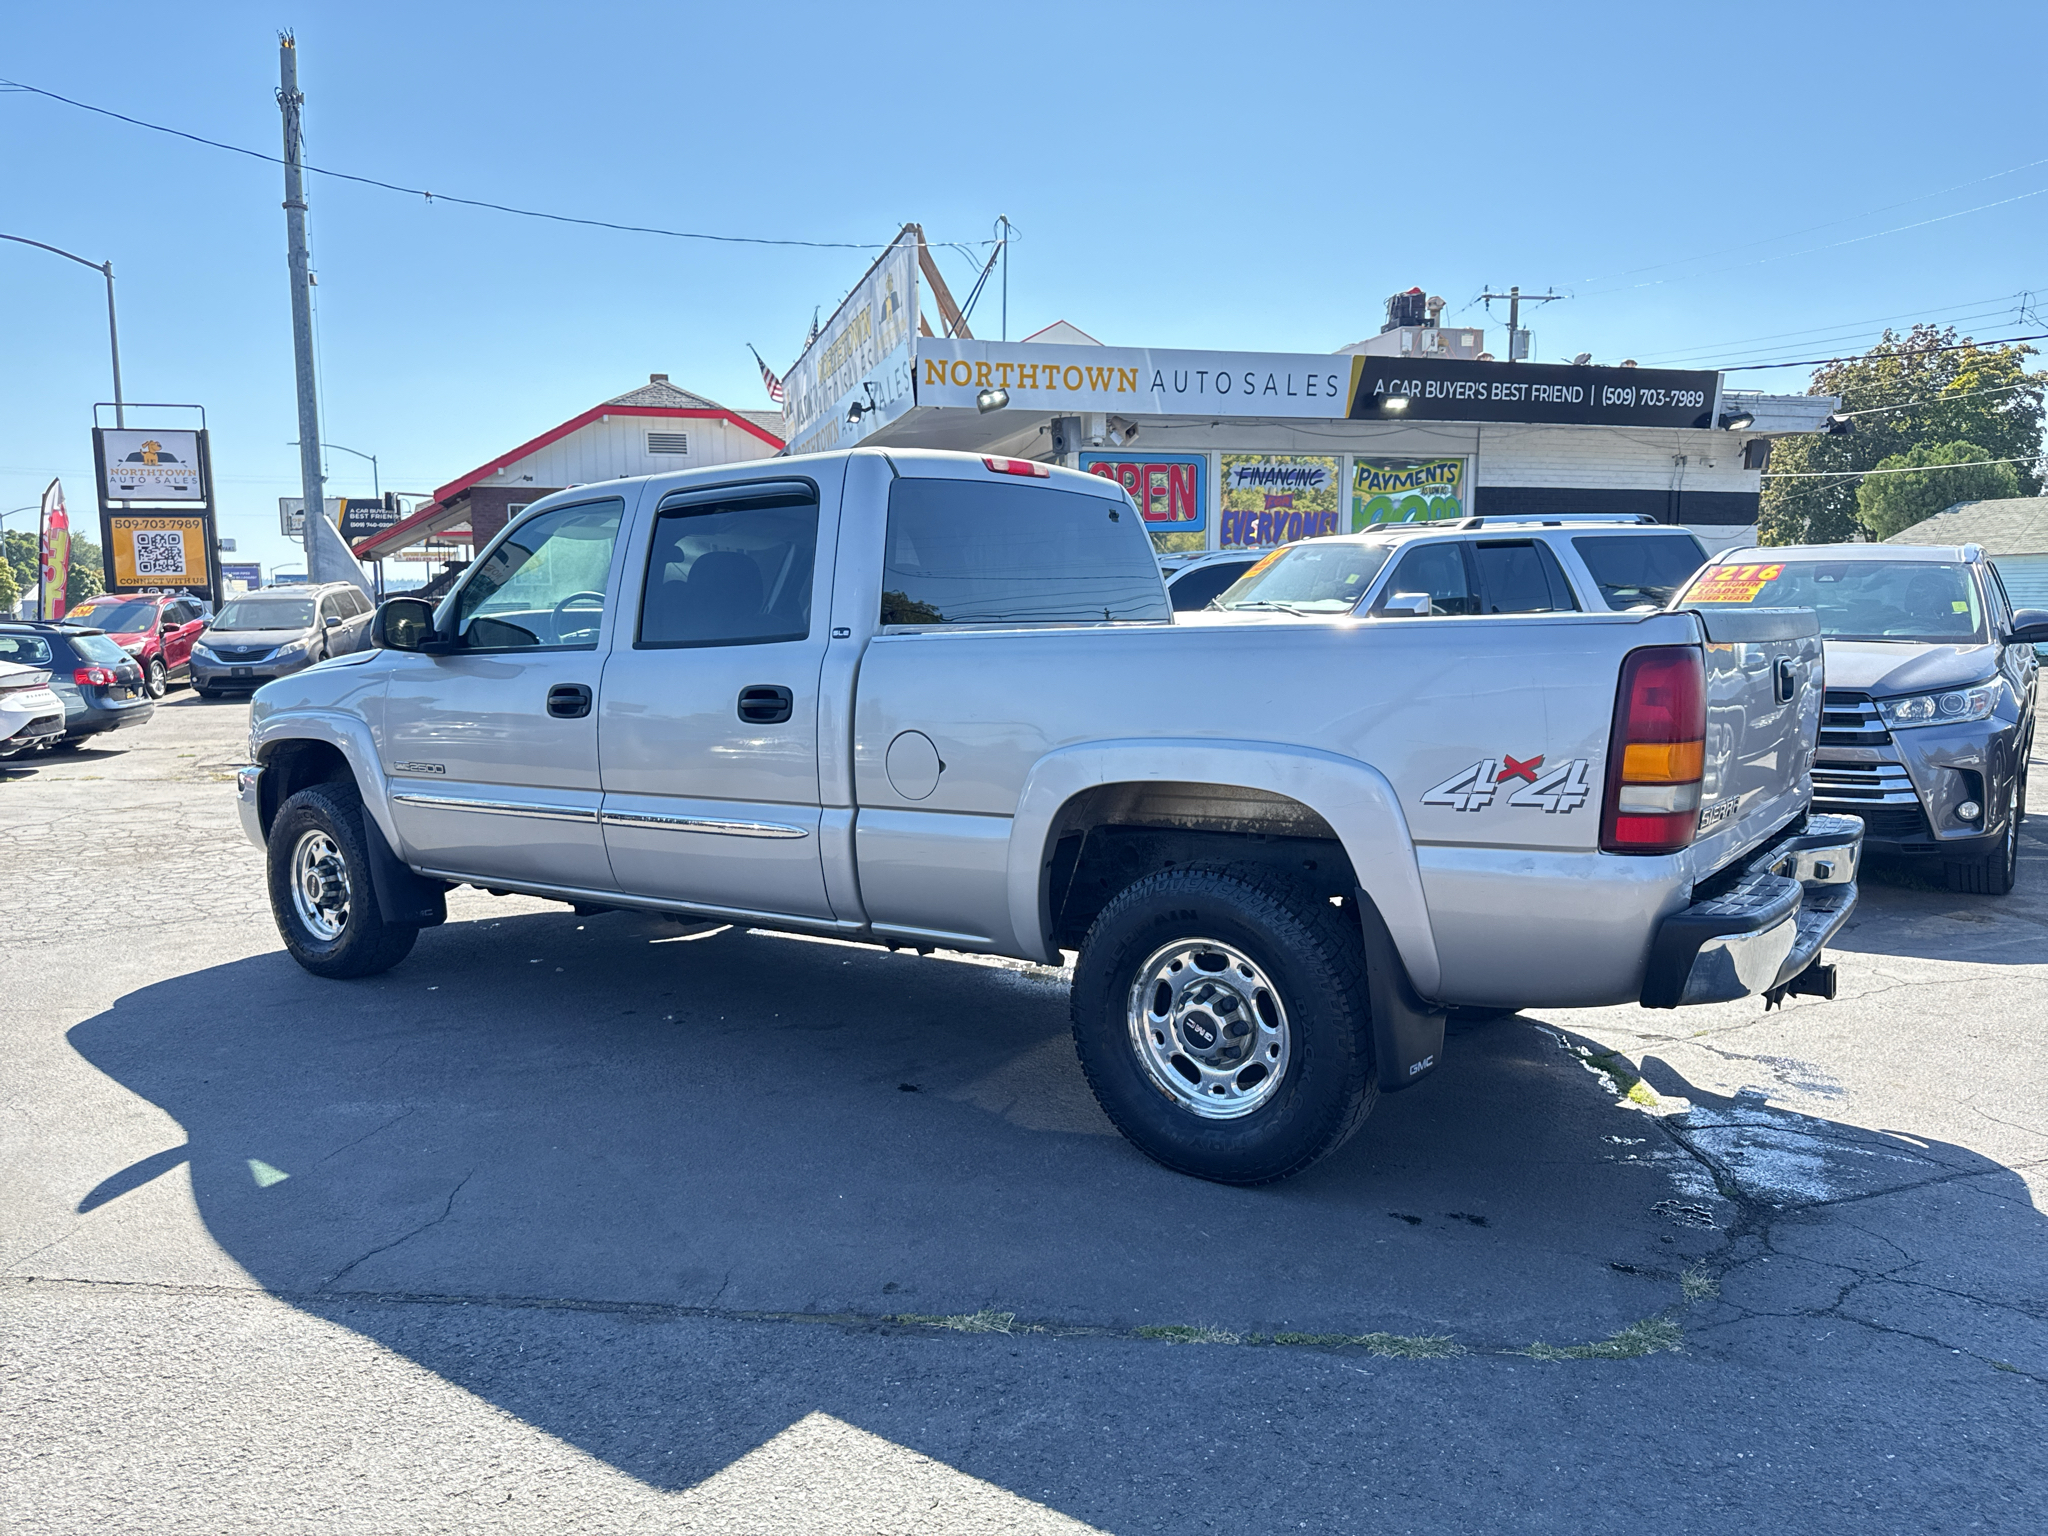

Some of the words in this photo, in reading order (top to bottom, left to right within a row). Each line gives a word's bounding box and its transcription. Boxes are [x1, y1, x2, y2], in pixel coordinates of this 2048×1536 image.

[925, 359, 1139, 393] NORTHTOWN
[1150, 369, 1232, 395] AUTO
[1243, 371, 1338, 397] SALES
[1374, 379, 1385, 396] A
[1389, 379, 1421, 398] CAR
[1426, 380, 1487, 400] BUYER'S
[1491, 383, 1528, 401] BEST
[1531, 384, 1583, 403] FRIEND
[1602, 385, 1635, 407] (509)
[1640, 388, 1704, 408] 703-7989
[110, 468, 196, 476] NORTHTOWN
[1237, 467, 1324, 486] FINANCING
[1358, 463, 1458, 491] PAYMENTS
[115, 520, 200, 529] 509-703-7989
[1220, 509, 1338, 546] EVERYONE!
[120, 577, 164, 585] CONNECT
[1700, 795, 1740, 829] SIERRA
[1186, 1018, 1214, 1042] GMC
[1409, 1054, 1434, 1075] GMC
